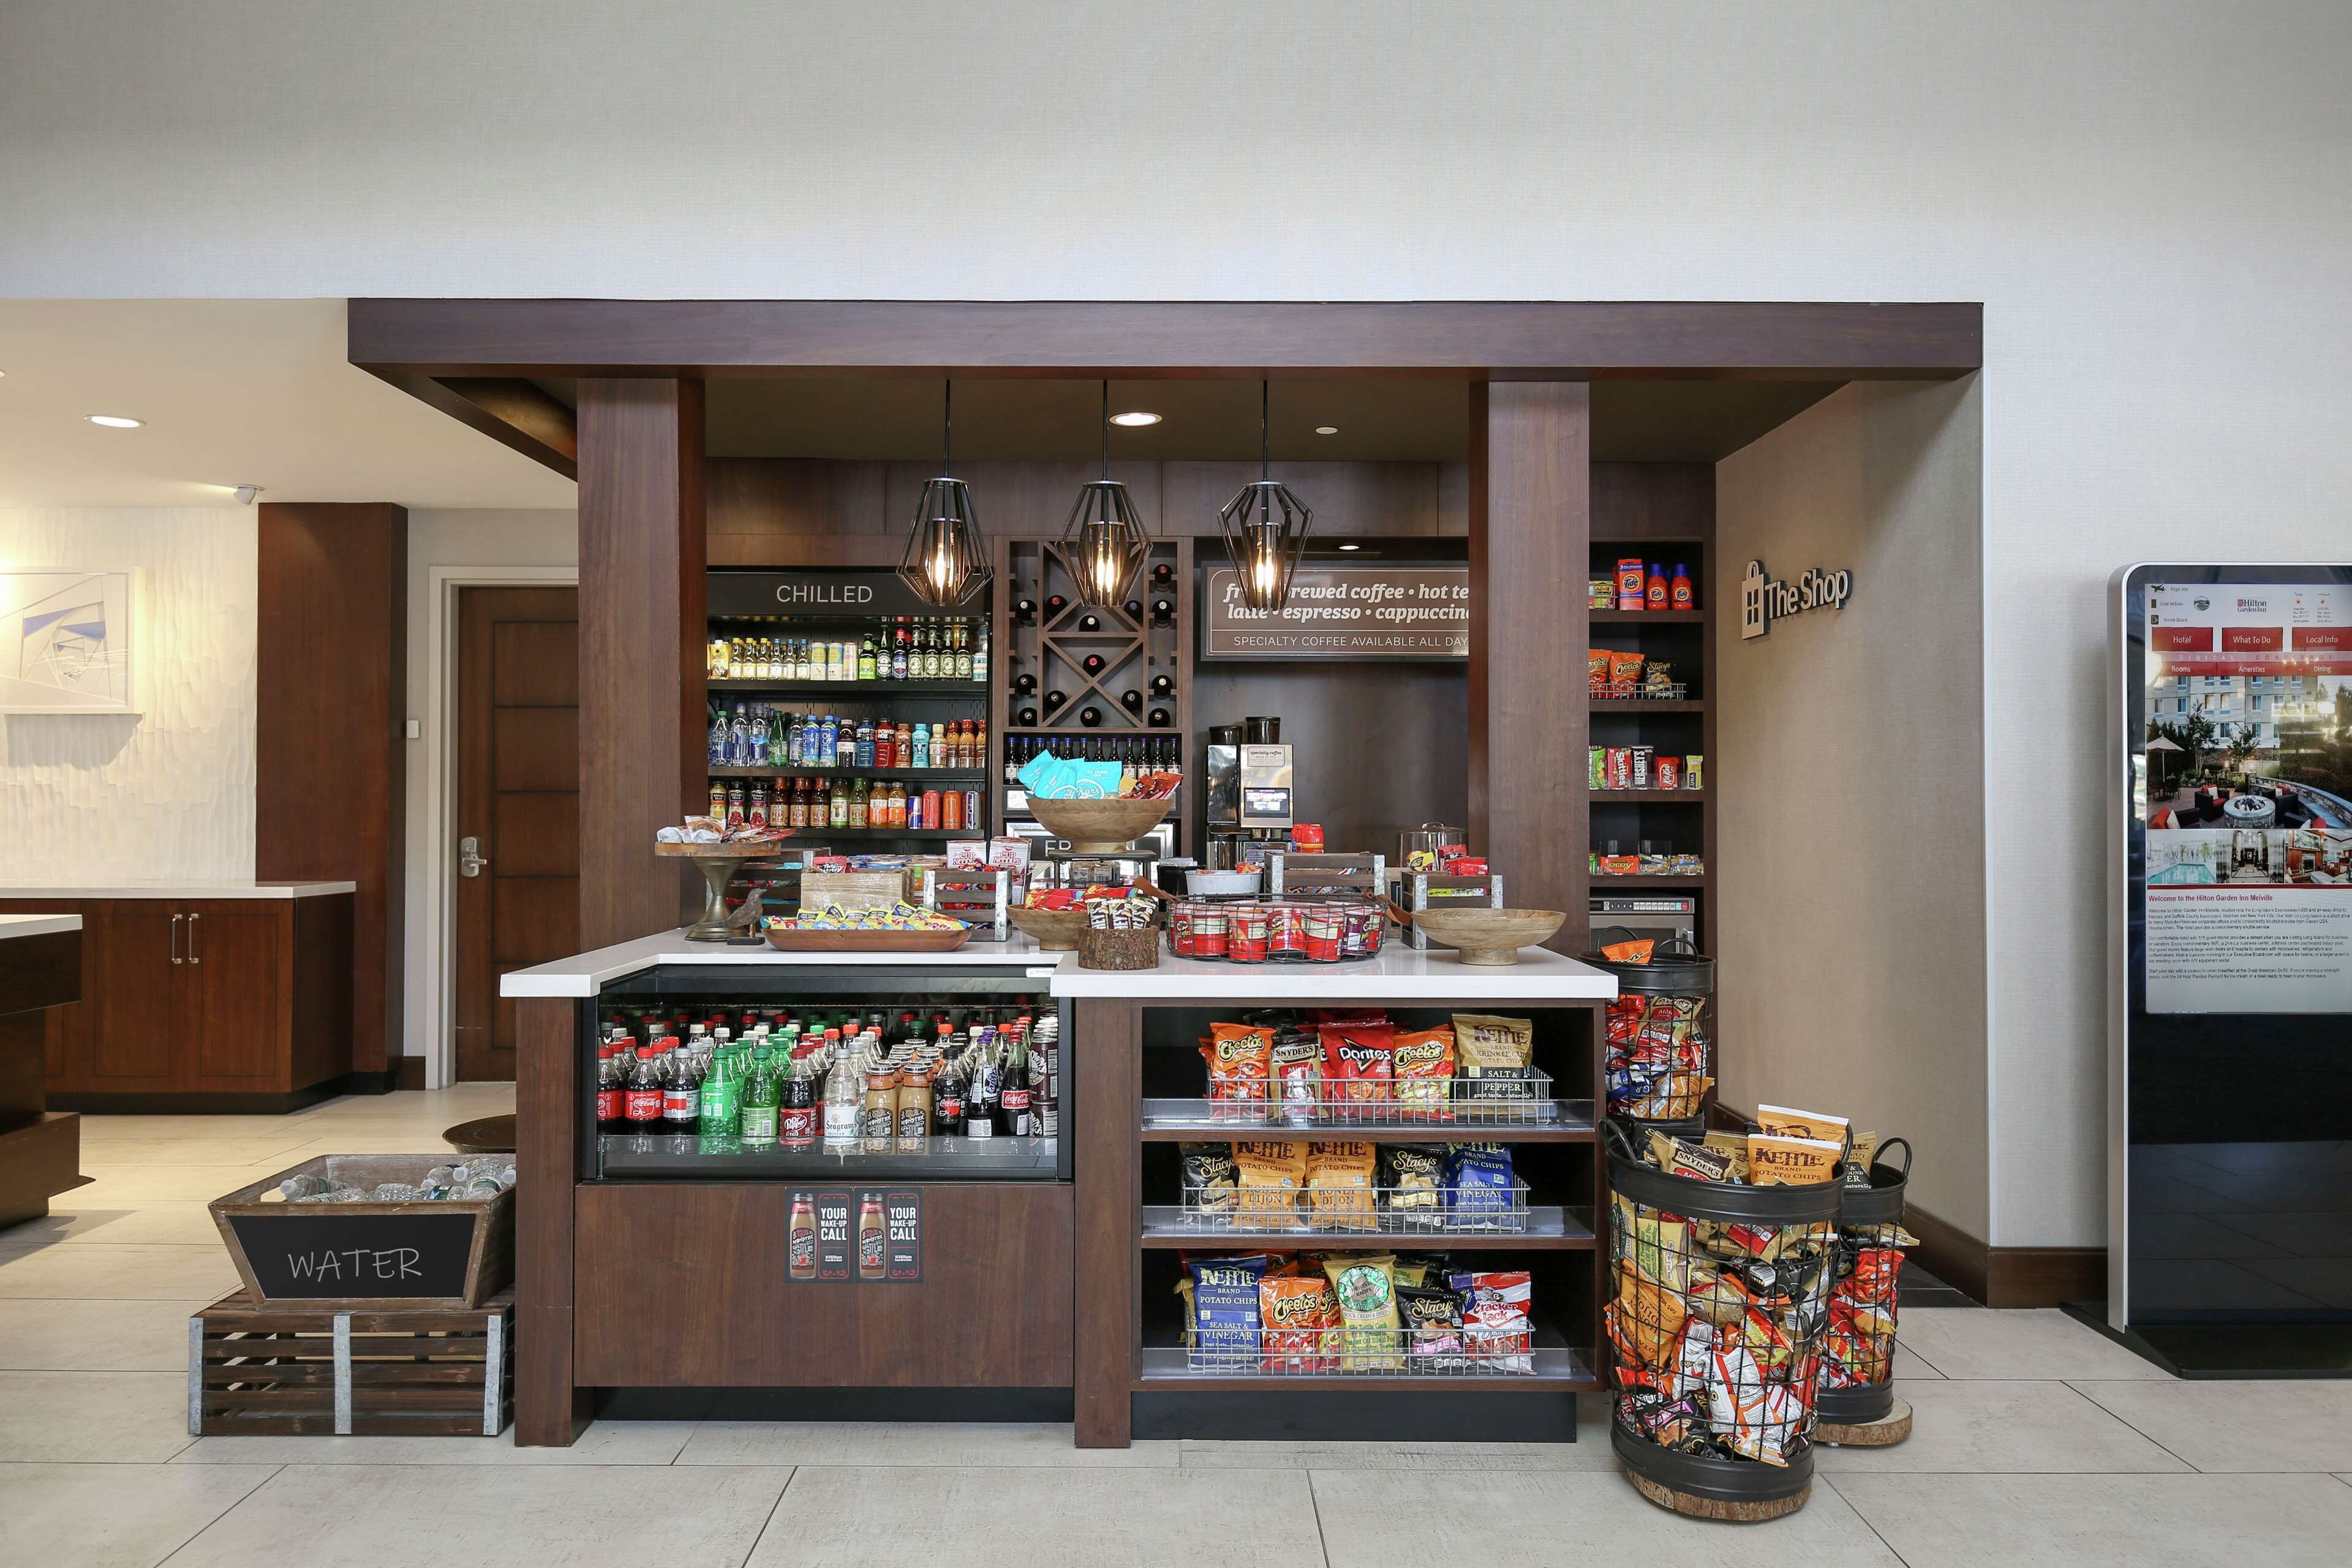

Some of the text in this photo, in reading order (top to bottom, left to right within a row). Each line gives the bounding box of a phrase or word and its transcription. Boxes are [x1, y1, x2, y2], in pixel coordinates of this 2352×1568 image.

[1623, 578, 1638, 589] Tide
[776, 585, 873, 603] CHILLED
[1287, 584, 1348, 599] rewed
[1351, 584, 1404, 603] coffee
[1418, 584, 1448, 600] hot
[1452, 585, 1469, 600] te
[1651, 589, 1663, 598] Tide
[1676, 589, 1687, 598] Tide
[1765, 568, 1849, 619] The Shop
[2244, 598, 2267, 607] Hilton
[1283, 607, 1361, 623] espresso
[1234, 636, 1468, 647] SPECIALTY COFFEE AVAILABLE ALL DAY
[1616, 662, 1641, 676] Cheetos
[1616, 752, 1627, 786] Skittles
[1471, 1023, 1529, 1045] KETTLE
[1218, 1033, 1265, 1062] Cheetos
[1275, 1045, 1314, 1057] SNYDER'S
[1340, 1047, 1392, 1061] Doritos
[1393, 1041, 1444, 1068] Cheetos
[1485, 1083, 1521, 1091] PEPPER
[786, 1119, 805, 1130] Pepper
[1236, 1142, 1296, 1159] KETTLE
[1754, 1147, 1826, 1167] KETTLE
[1200, 1156, 1235, 1178] Stacy's
[1393, 1151, 1437, 1173] Stacy's
[1678, 1153, 1721, 1178] SNYDER'S
[1755, 1170, 1790, 1178] POTATO
[1248, 1194, 1282, 1204] DIJON
[1456, 1190, 1504, 1199] VINEGAR
[821, 1207, 847, 1219] YOUR
[890, 1207, 916, 1219] YOUR
[821, 1228, 847, 1240] CALL
[890, 1227, 916, 1240] CALL
[288, 1248, 422, 1282] WATER
[1198, 1267, 1259, 1287] KETTLE
[1273, 1294, 1318, 1323] Cheetos
[1411, 1298, 1454, 1319] Stacy's
[1474, 1302, 1519, 1314] Cracker
[1479, 1311, 1509, 1324] Jack
[1205, 1331, 1254, 1340] VINEGAR
